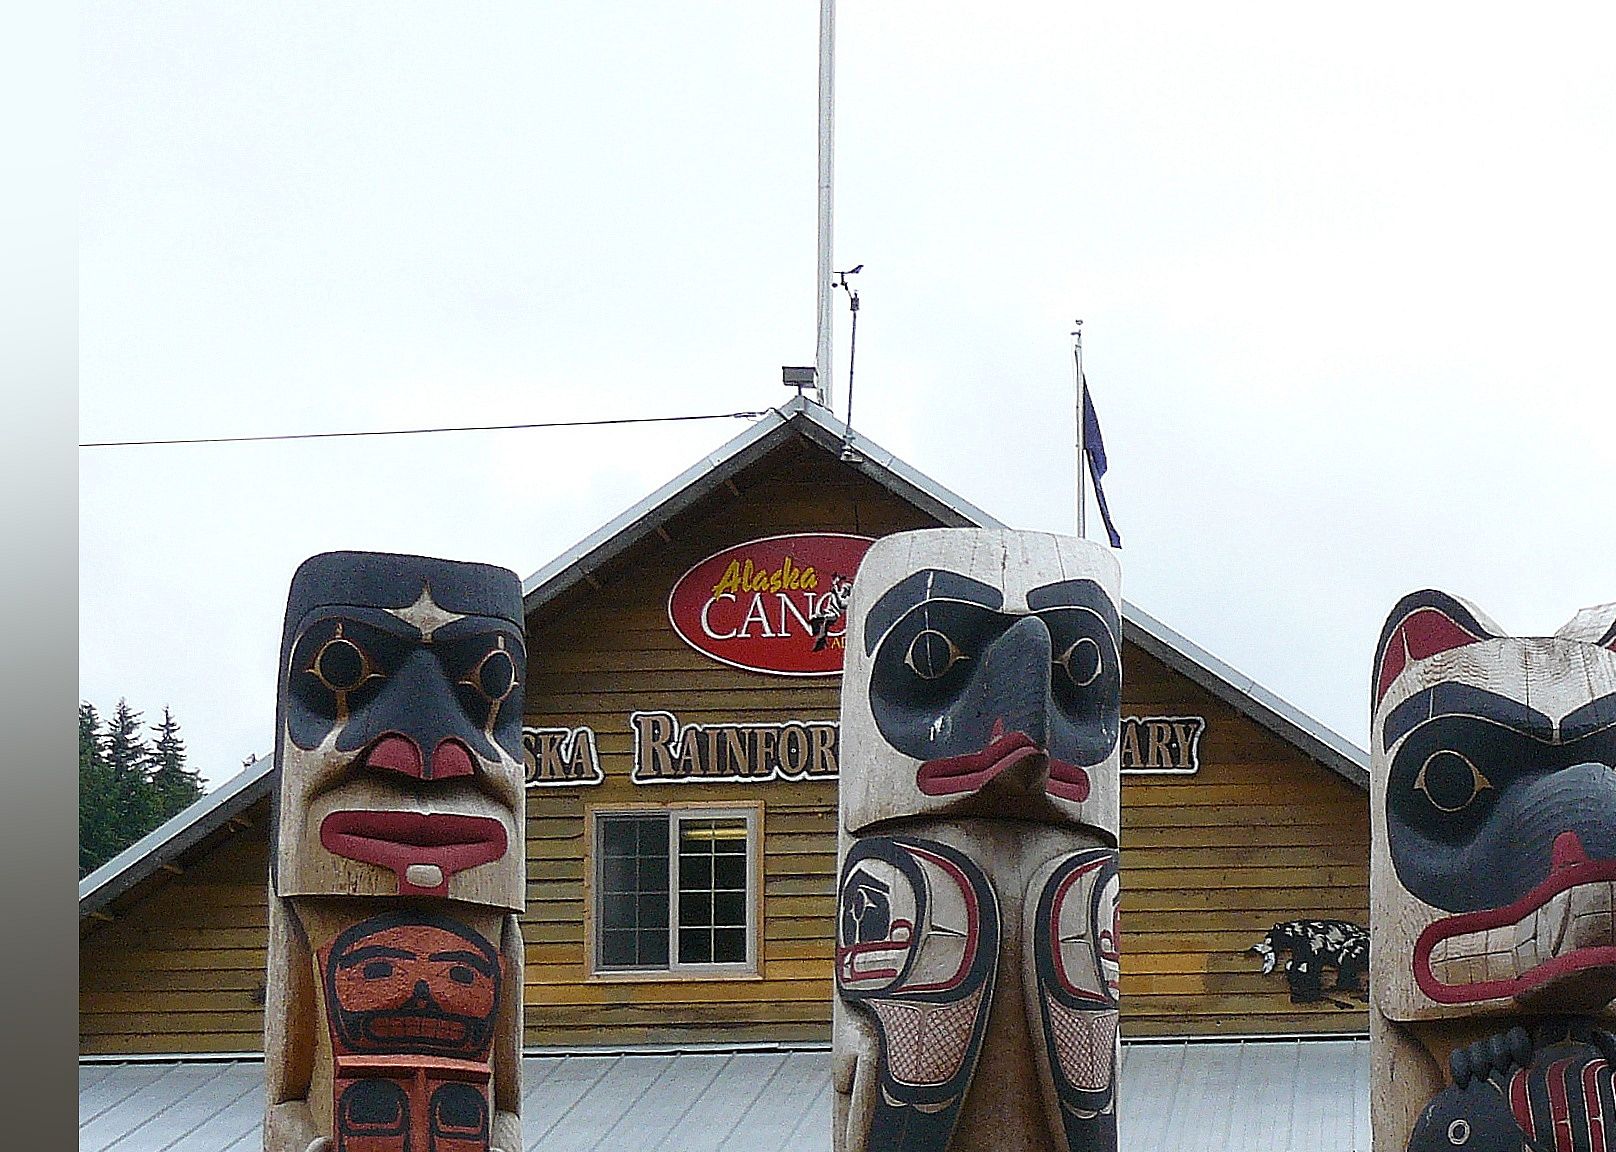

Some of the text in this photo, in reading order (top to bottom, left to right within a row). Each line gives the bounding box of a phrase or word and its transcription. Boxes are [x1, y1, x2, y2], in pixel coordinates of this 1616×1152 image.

[712, 557, 819, 599] Alaska
[523, 715, 1198, 780] SKA RAINFOR ARY
